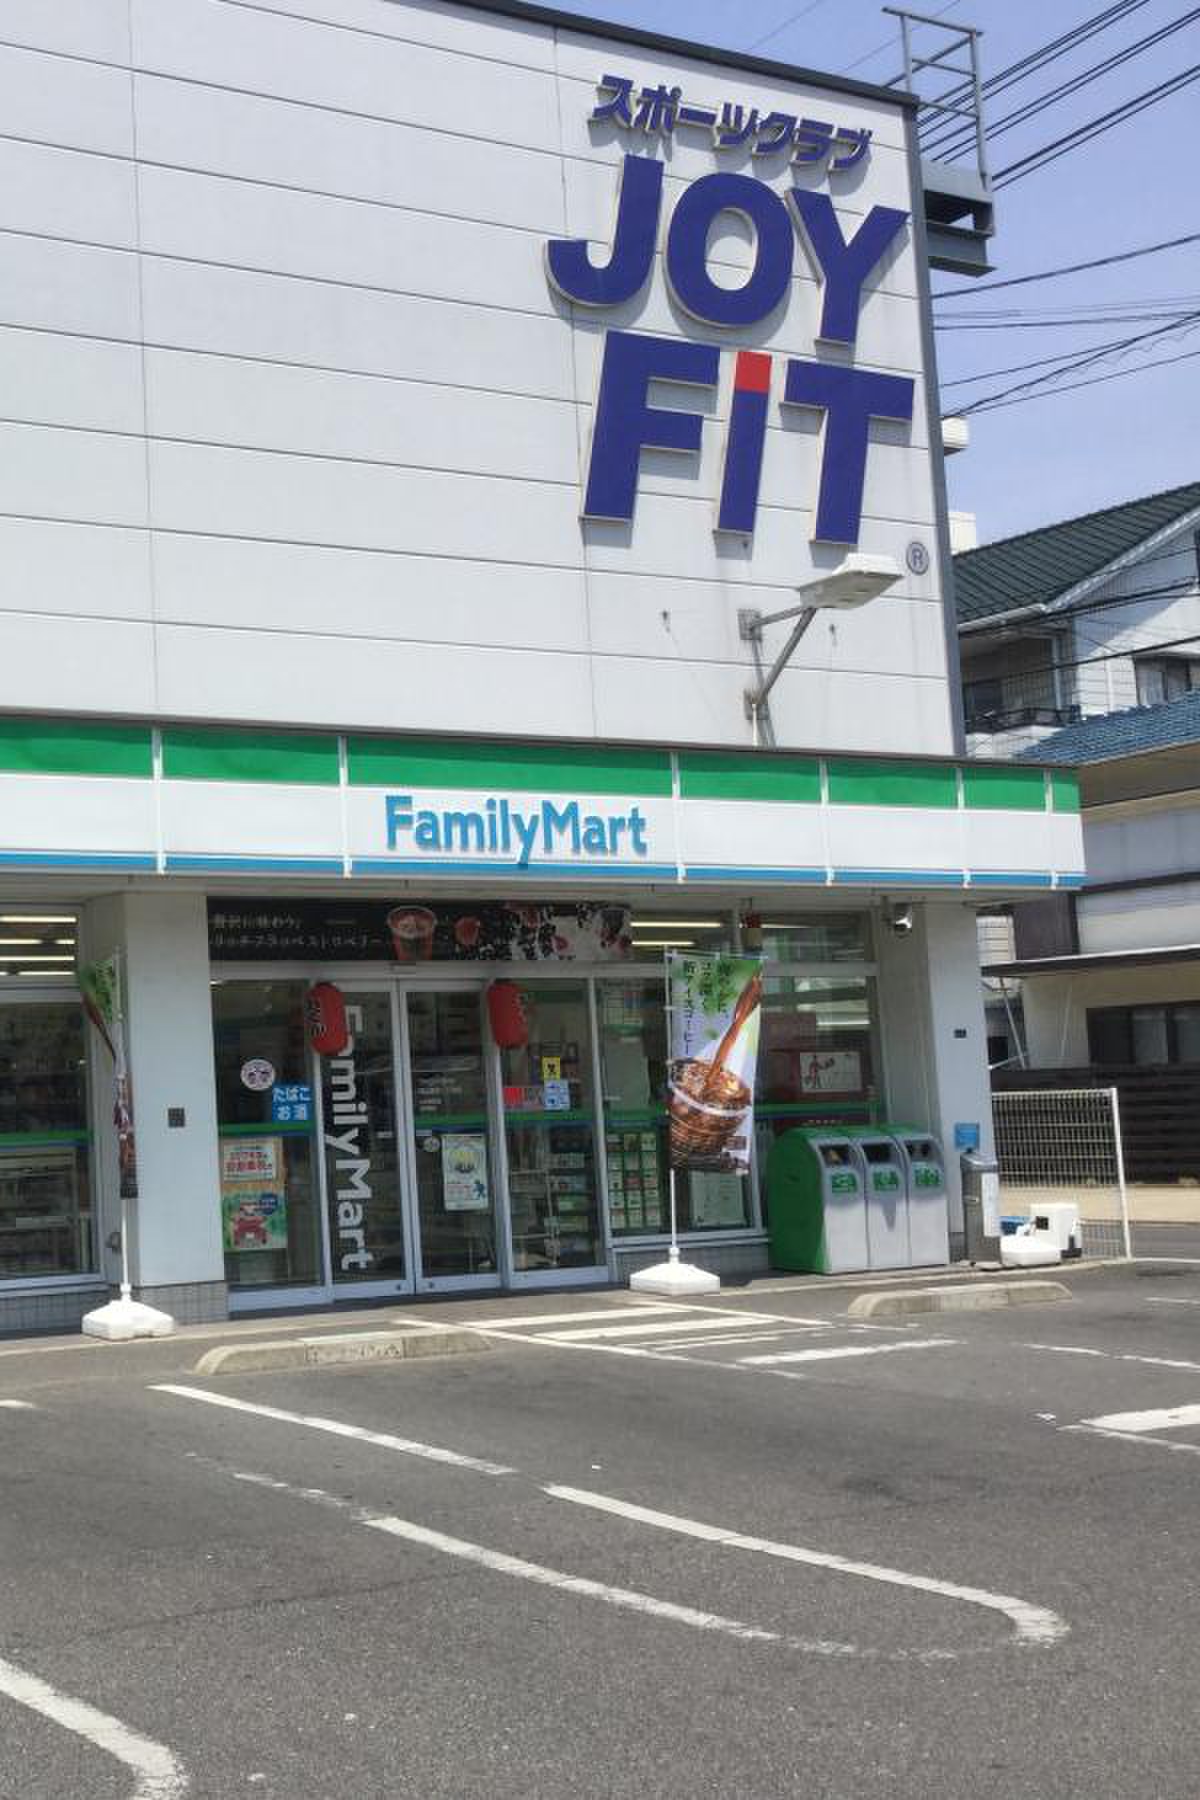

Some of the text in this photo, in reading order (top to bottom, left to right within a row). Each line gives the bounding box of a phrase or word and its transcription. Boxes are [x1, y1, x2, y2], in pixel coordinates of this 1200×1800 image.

[593, 74, 873, 170] スポーツクラブ
[545, 154, 910, 345] JOY
[385, 794, 648, 869] FamilyMart
[272, 1086, 311, 1103] たばこ
[322, 1004, 374, 1271] FmilyMart
